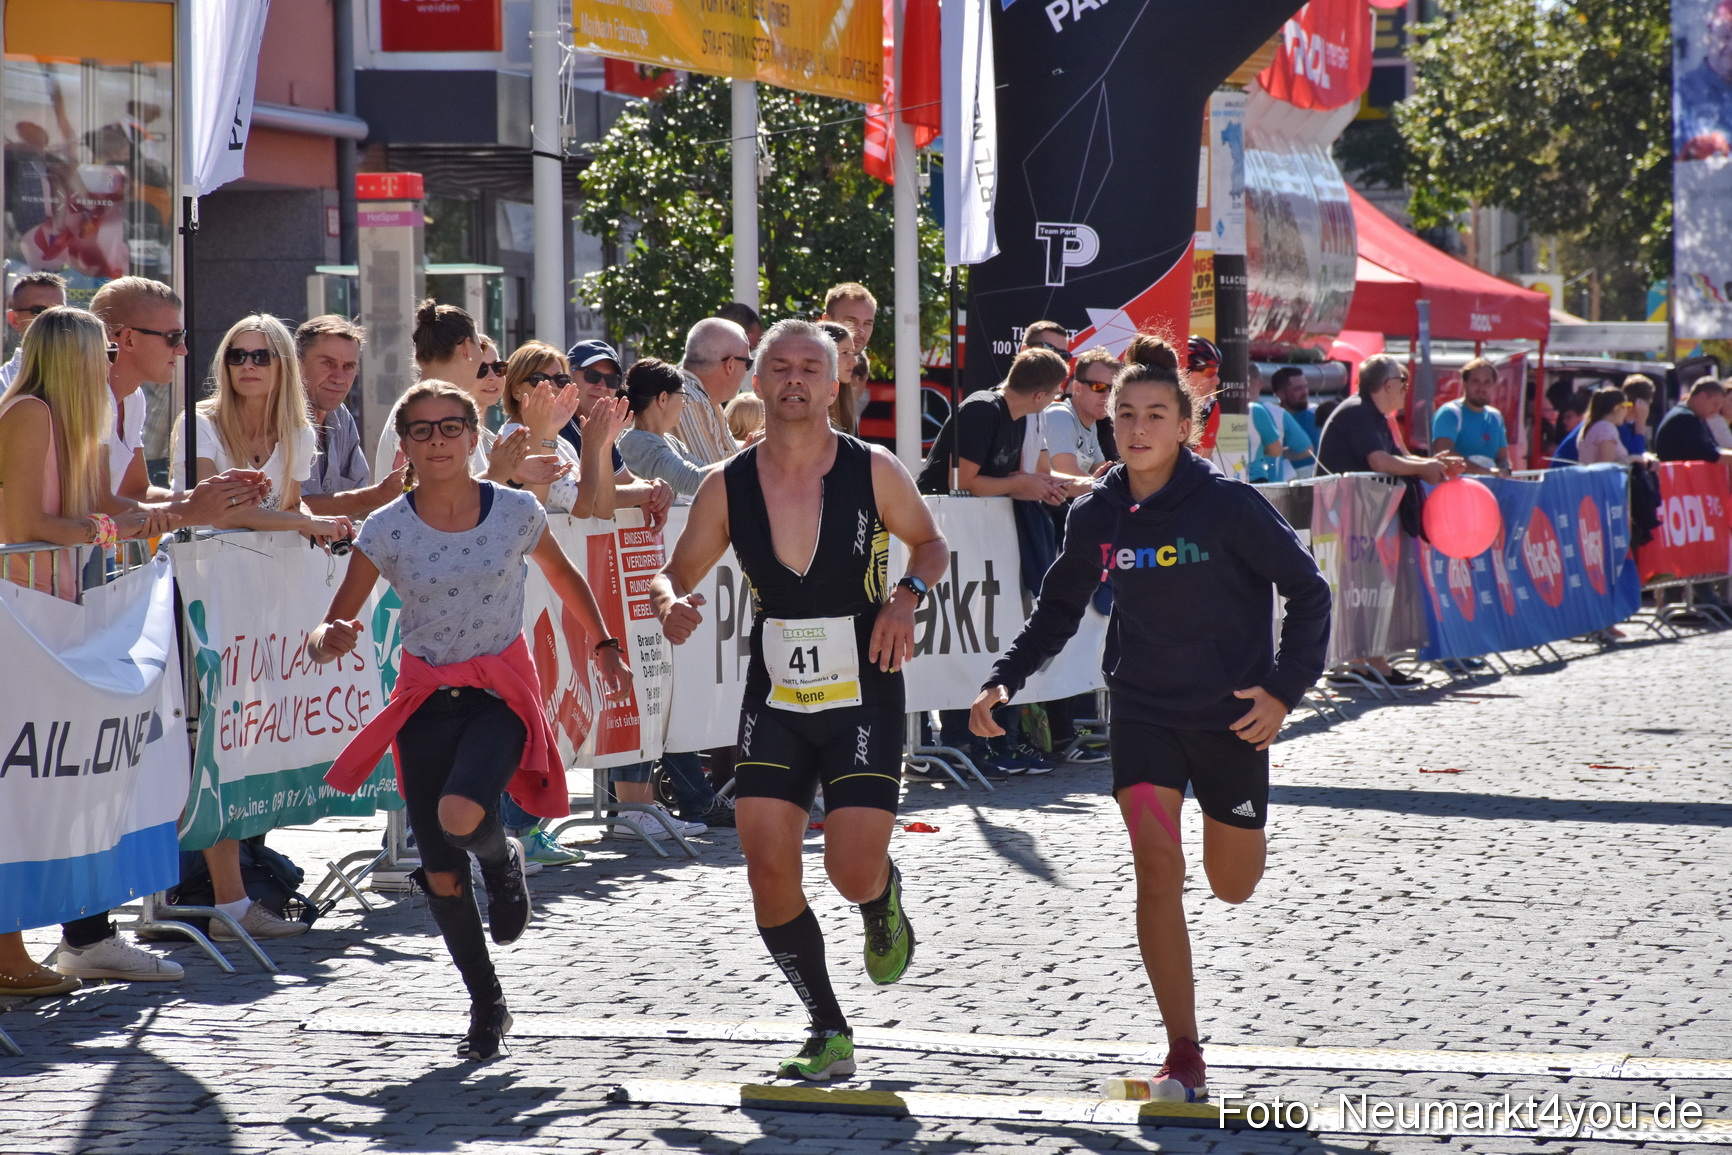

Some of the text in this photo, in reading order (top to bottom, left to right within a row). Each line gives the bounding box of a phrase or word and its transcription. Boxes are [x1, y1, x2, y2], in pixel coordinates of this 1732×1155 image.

[366, 213, 399, 222] HotSpot
[1040, 227, 1059, 235] Team
[993, 341, 1011, 354] 100
[783, 628, 826, 639] BOCK
[789, 646, 819, 674] 41
[800, 676, 829, 685] Neumarkt
[796, 691, 825, 703] Rene
